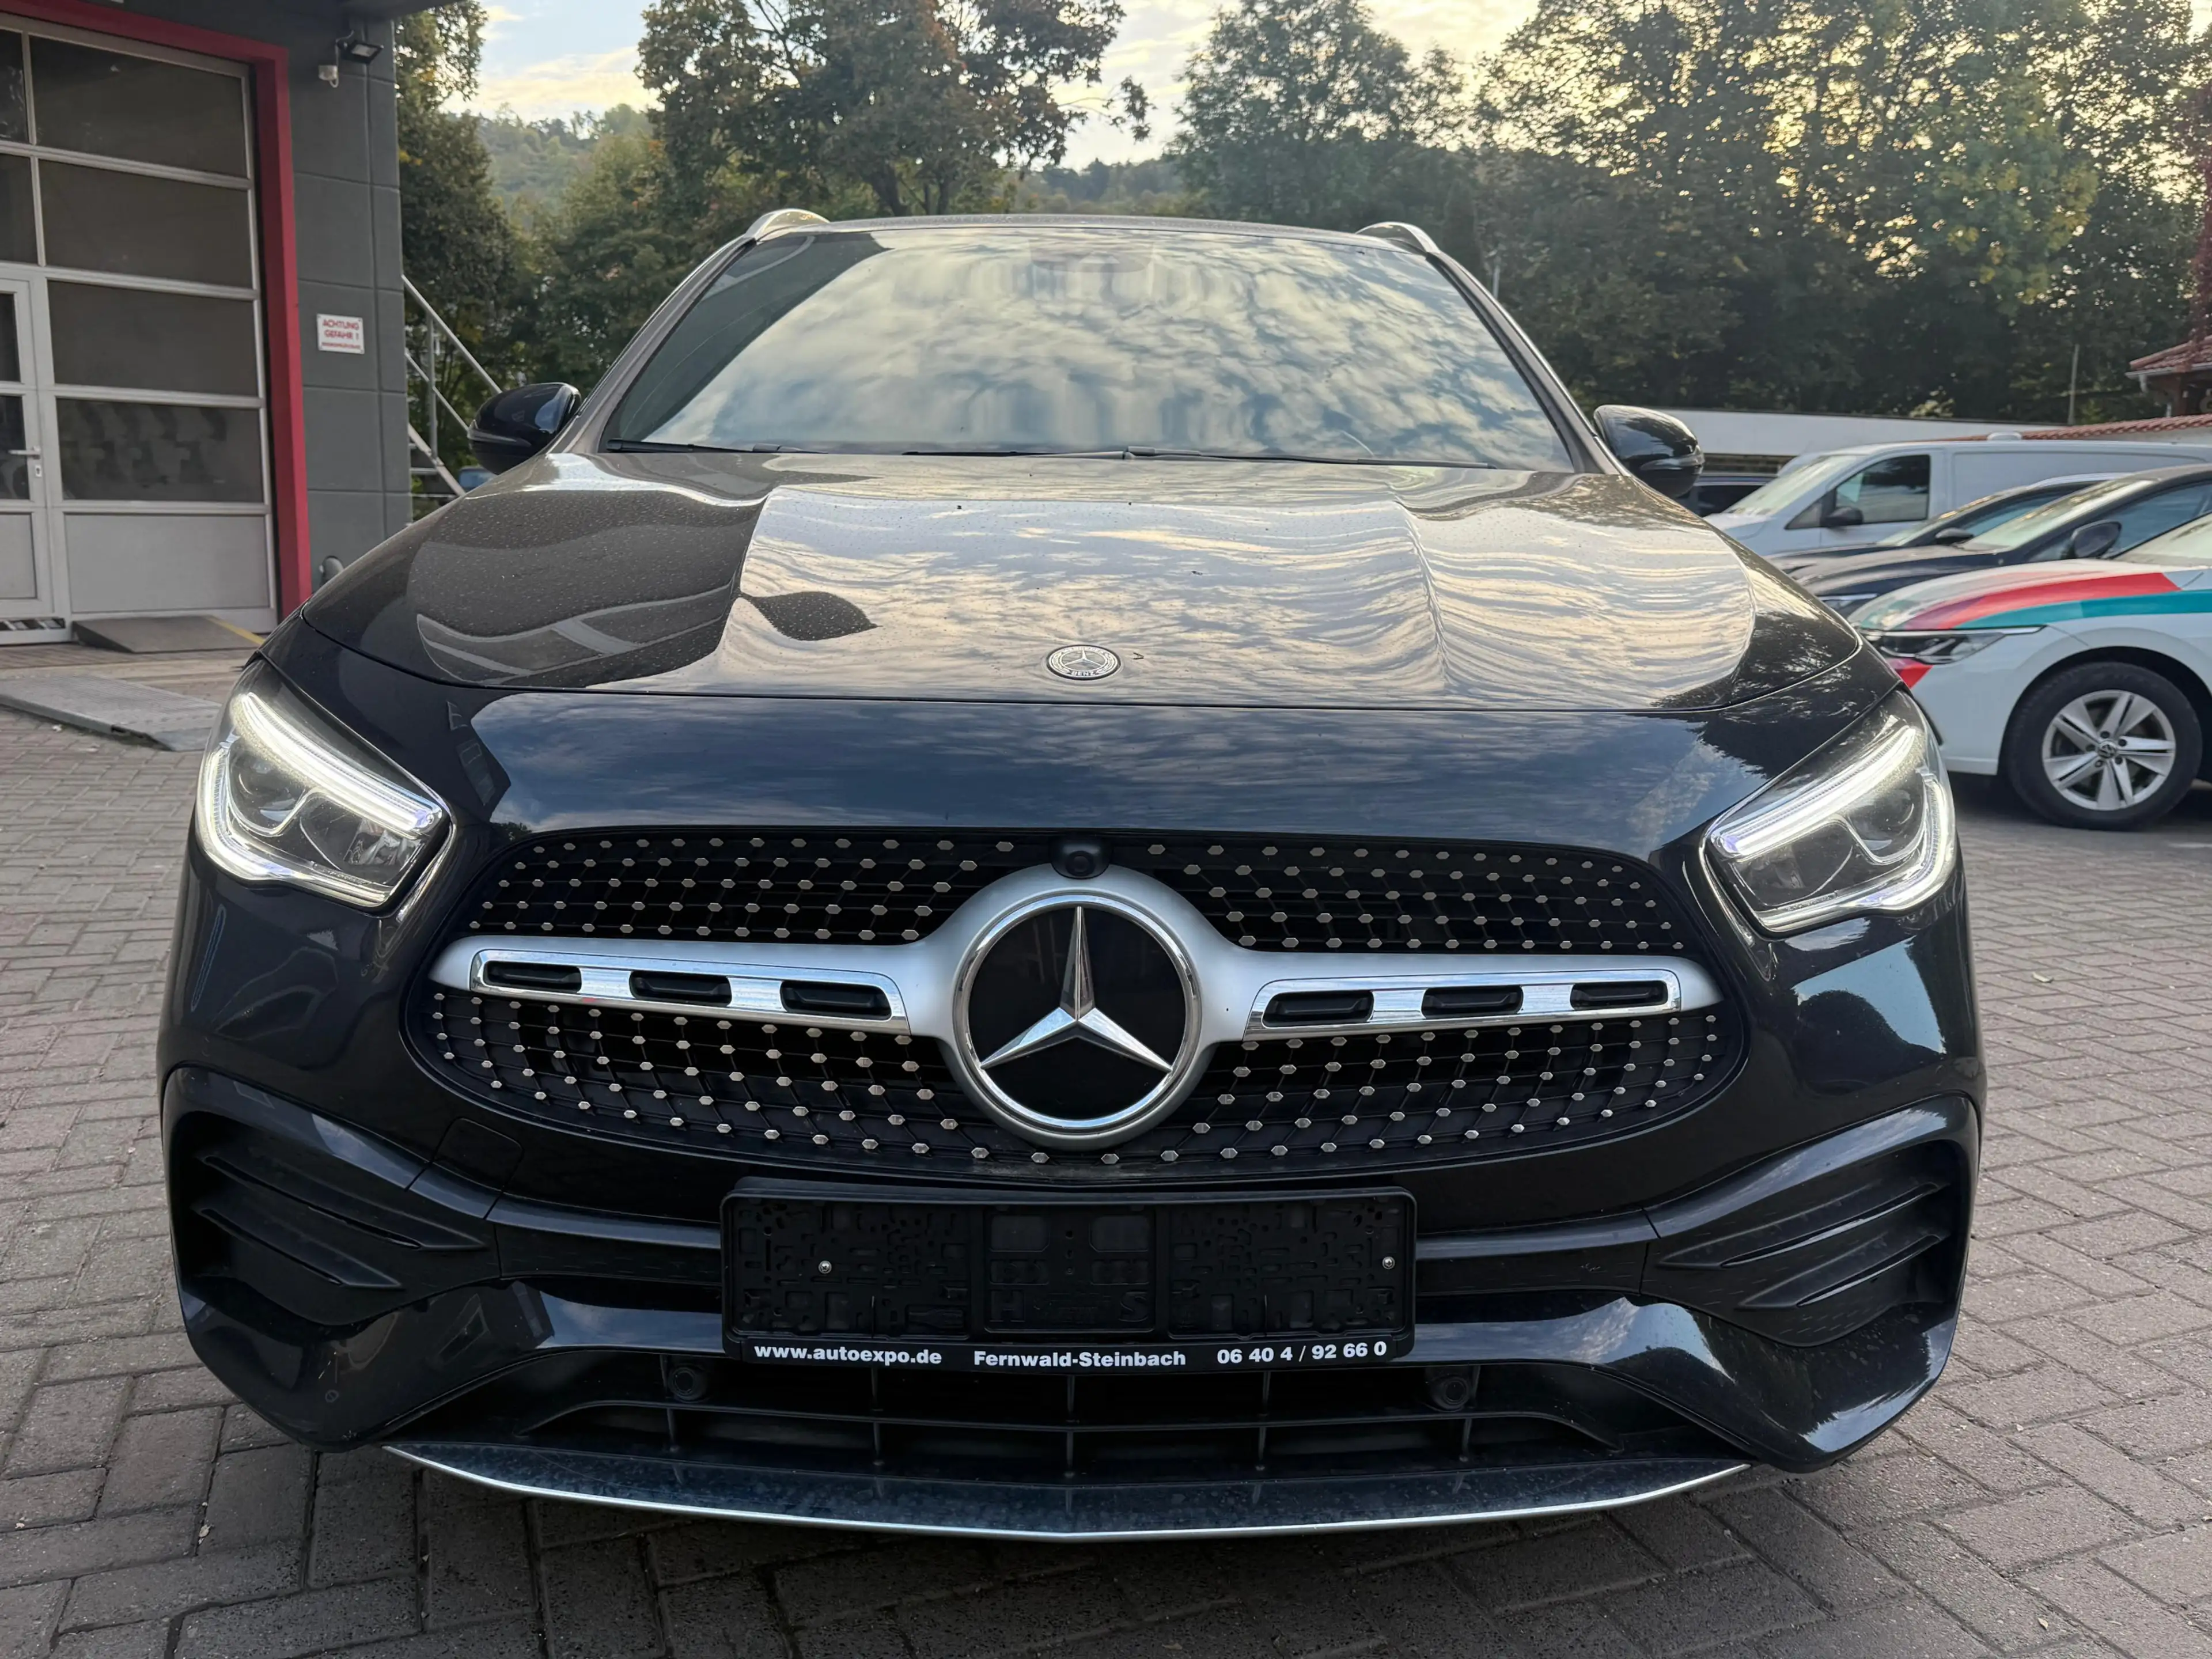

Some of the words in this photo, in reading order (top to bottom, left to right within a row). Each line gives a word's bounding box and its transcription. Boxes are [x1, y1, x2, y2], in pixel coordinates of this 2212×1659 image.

[323, 319, 359, 330] ACHTUNG
[324, 329, 353, 339] GEFAHR
[754, 1346, 942, 1366] www.autoexpo.de
[974, 1350, 1186, 1367] Fernwald-Steinbach
[1217, 1349, 1243, 1364] 06
[1248, 1347, 1274, 1362] 40
[1312, 1344, 1337, 1359] 92
[1343, 1342, 1368, 1358] 66
[1373, 1340, 1387, 1356] 0
